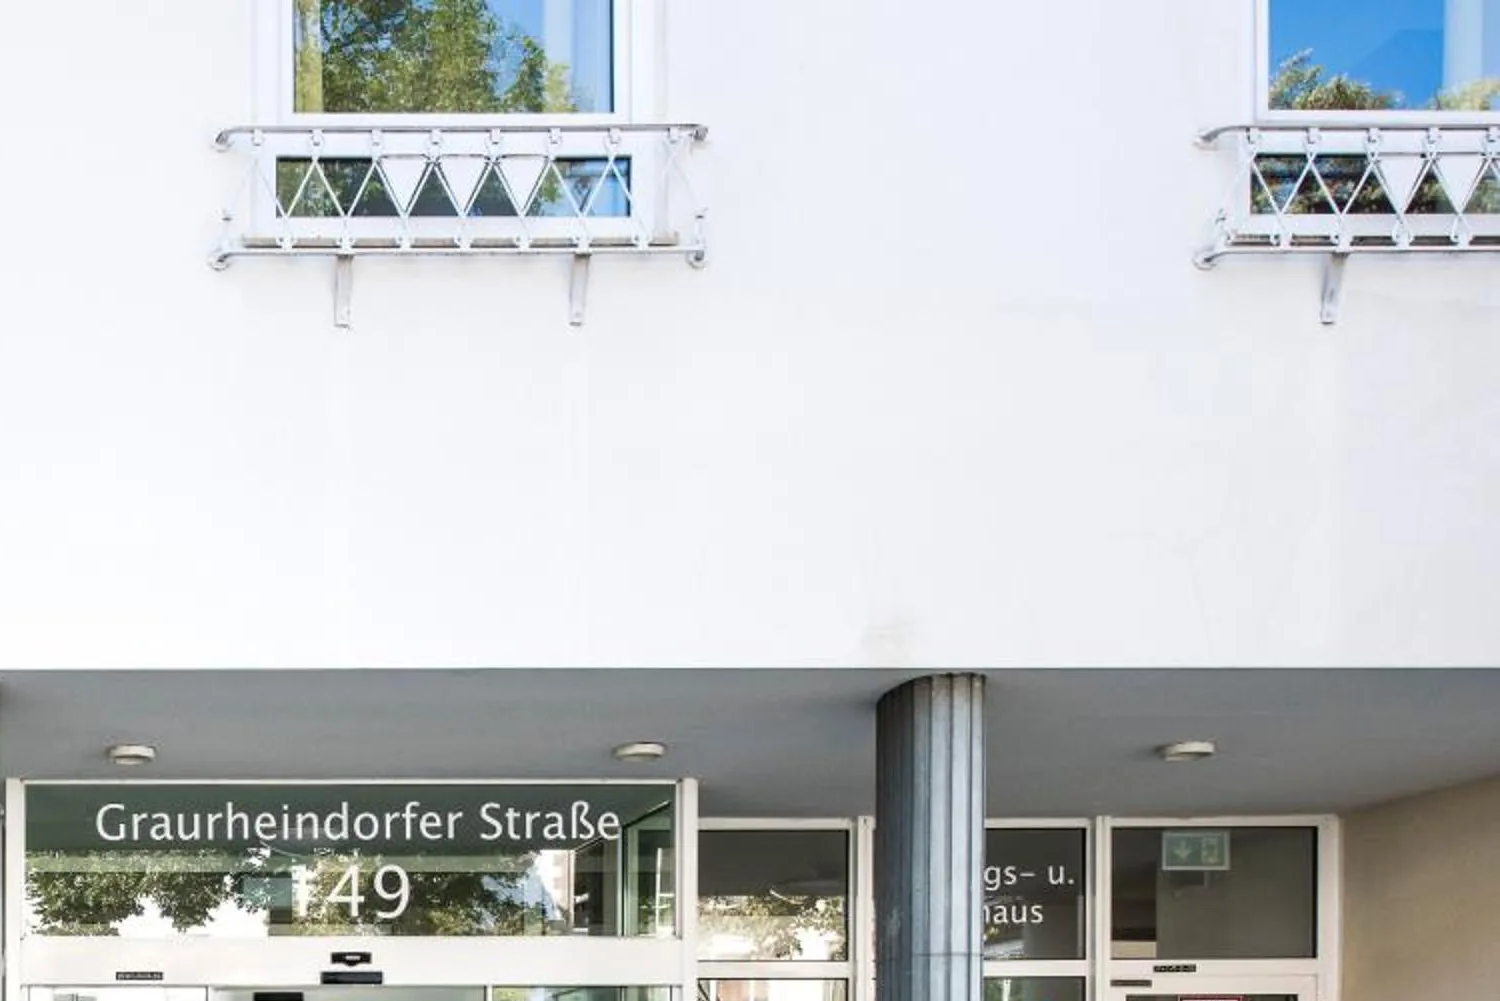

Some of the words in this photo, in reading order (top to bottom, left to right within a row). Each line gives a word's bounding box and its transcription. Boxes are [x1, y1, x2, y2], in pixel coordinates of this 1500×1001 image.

[95, 801, 464, 841] Graurheindorfer
[479, 800, 621, 841] Straße
[293, 864, 411, 919] 149
[1048, 865, 1075, 885] u.
